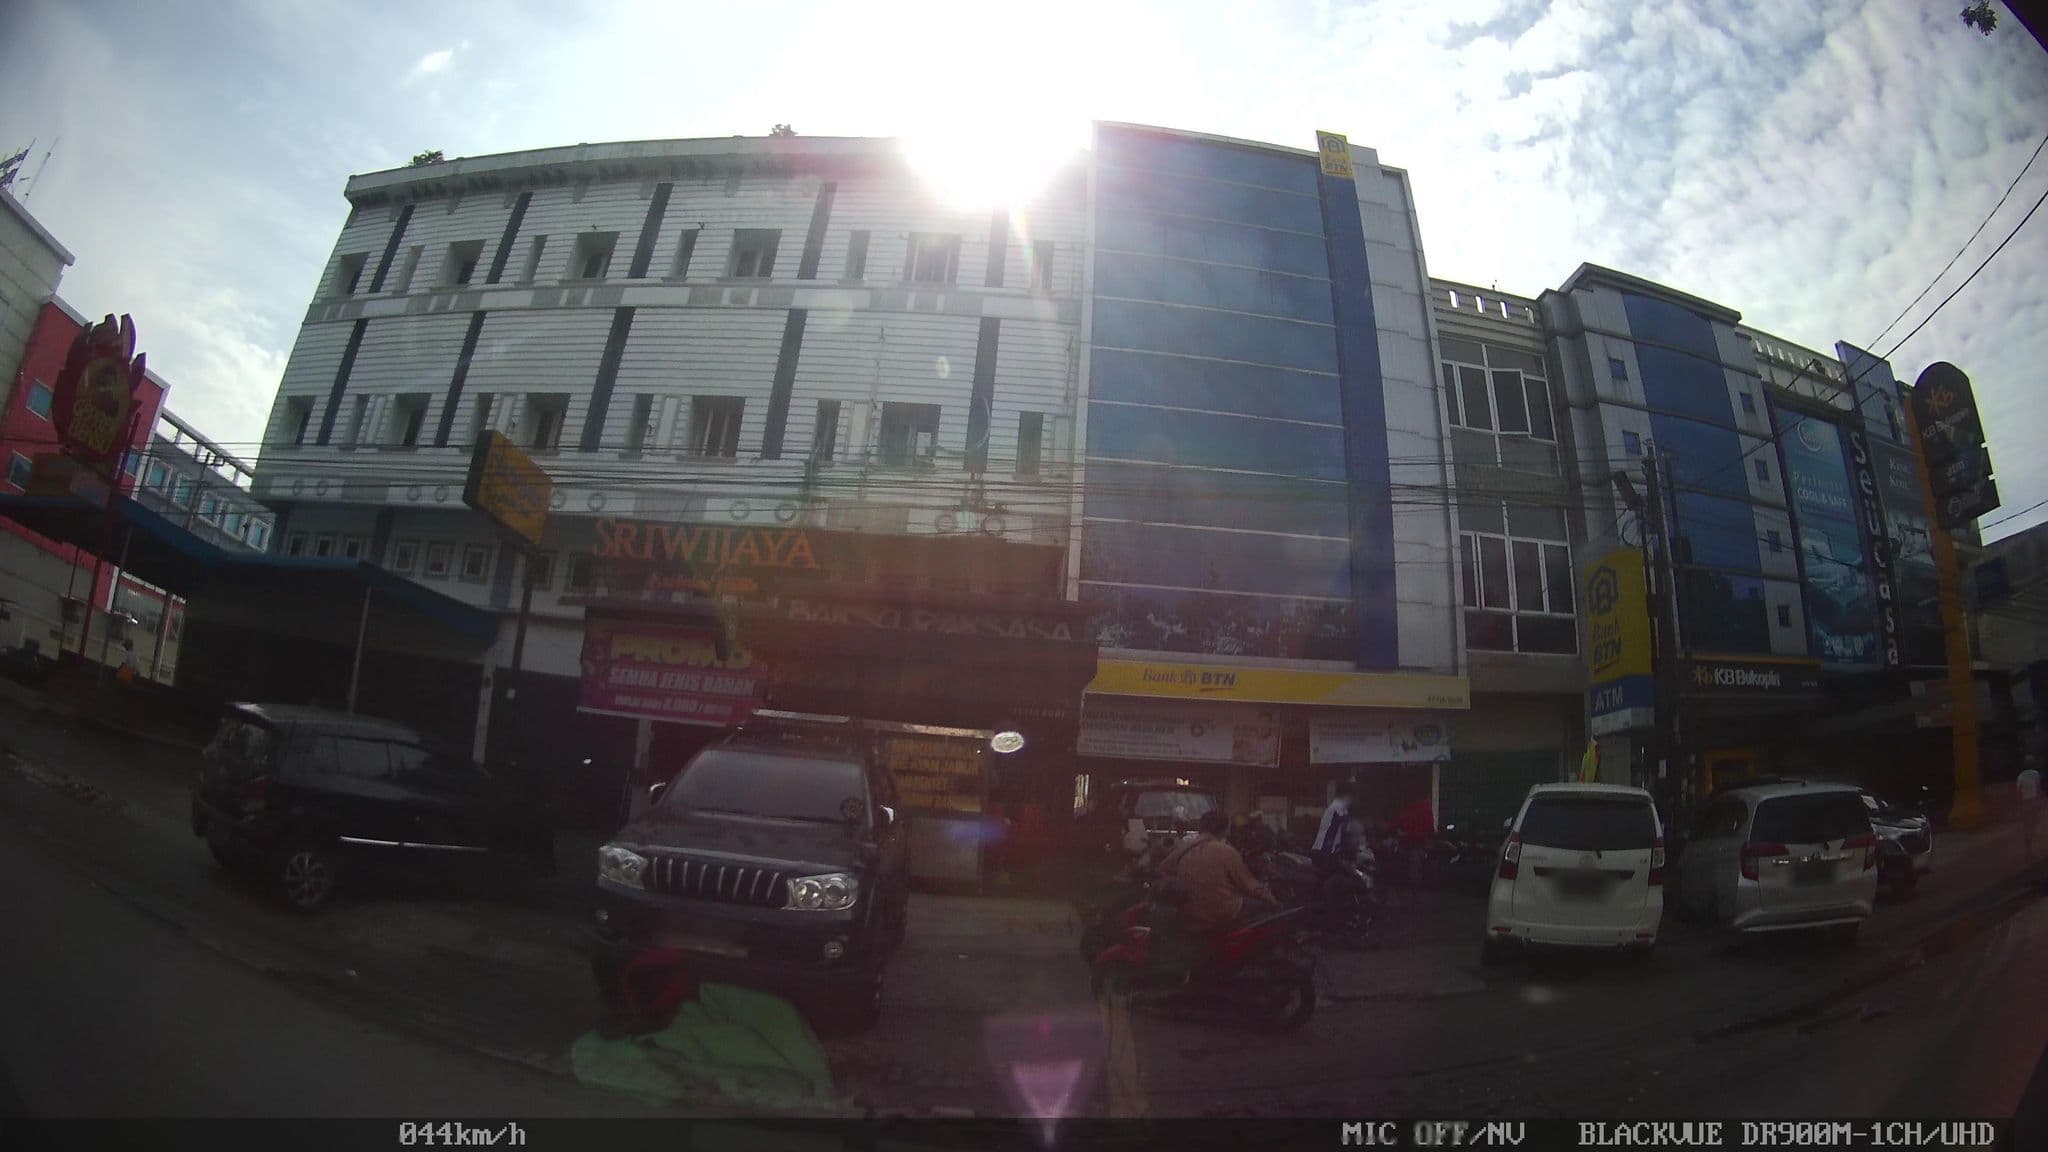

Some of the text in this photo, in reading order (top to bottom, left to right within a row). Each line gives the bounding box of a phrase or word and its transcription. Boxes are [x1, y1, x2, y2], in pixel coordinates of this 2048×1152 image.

[593, 516, 819, 574] SRIWIJAYA
[1593, 617, 1620, 641] Bank
[1593, 640, 1622, 664] BTN
[1143, 667, 1236, 686] Bank BTN
[1713, 667, 1735, 687] KB
[1735, 668, 1781, 691] Bukopin
[1594, 685, 1624, 712] ATM
